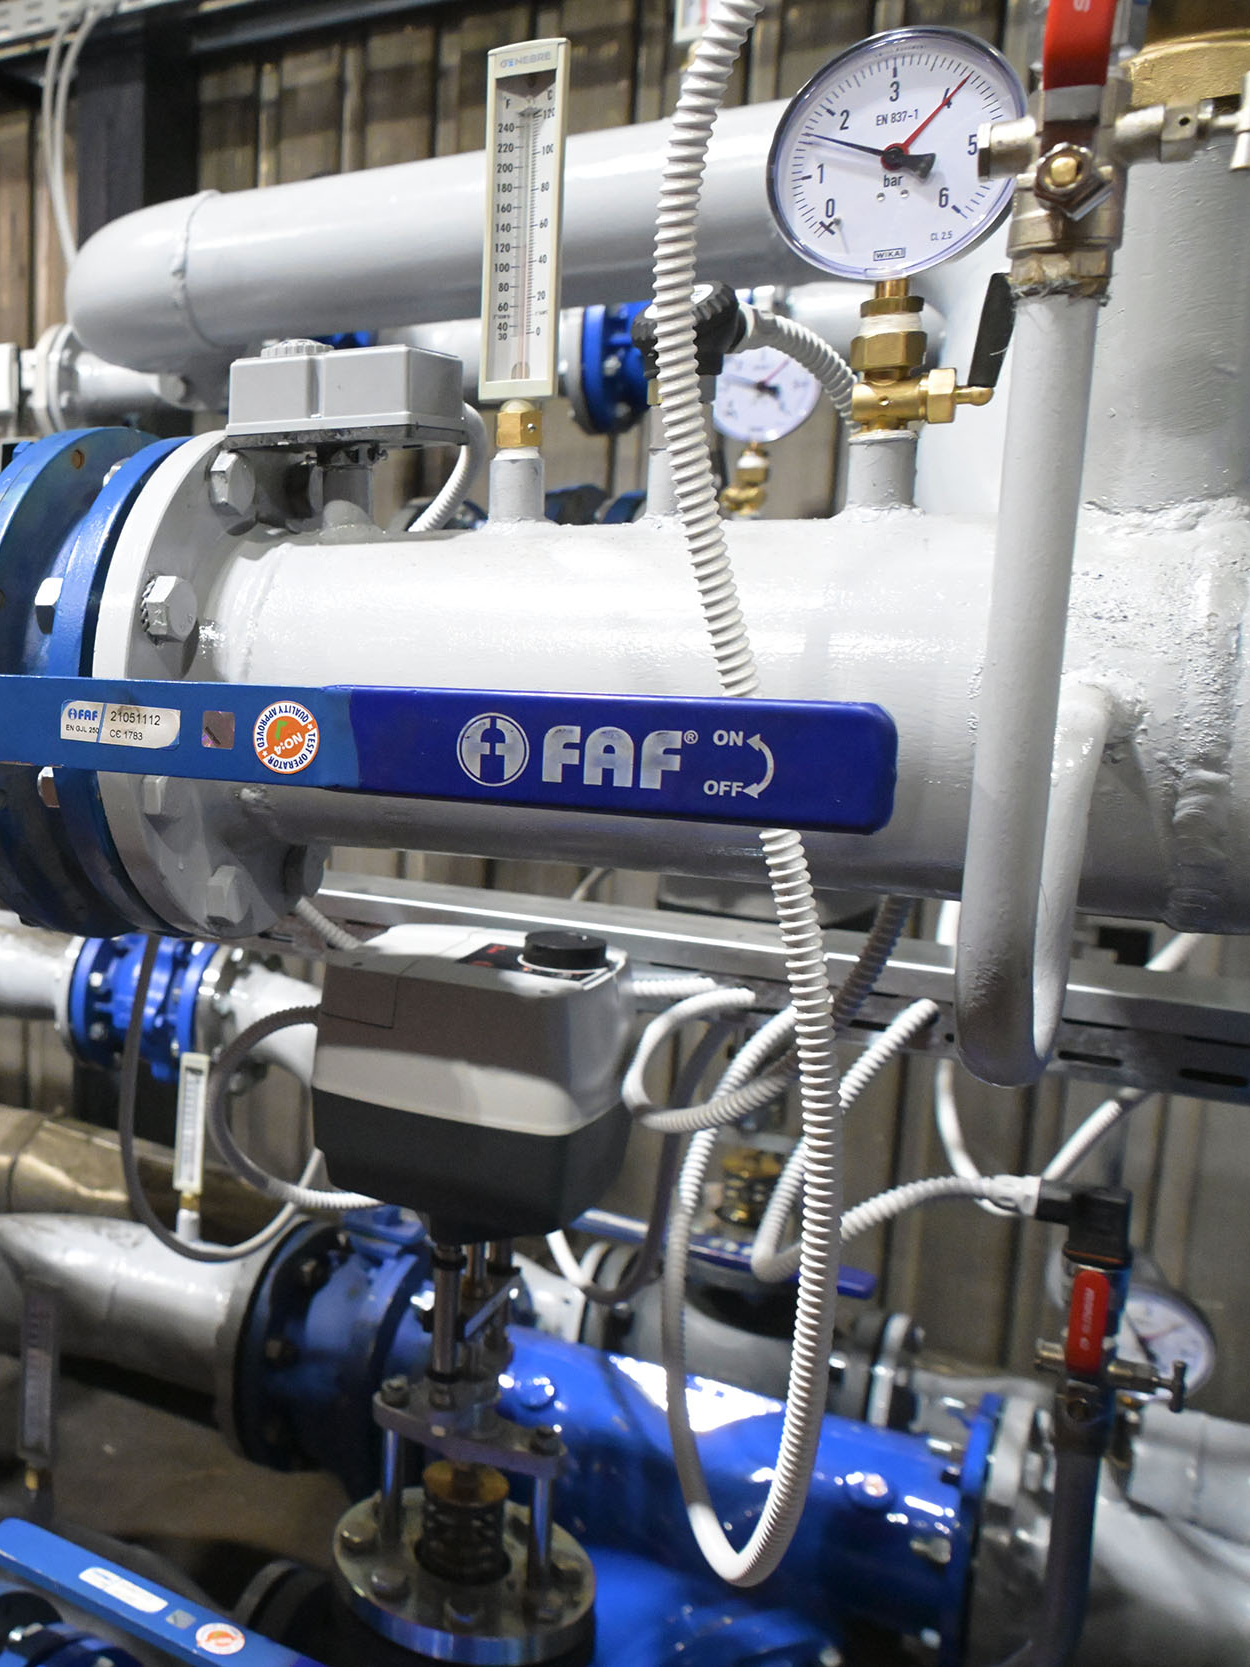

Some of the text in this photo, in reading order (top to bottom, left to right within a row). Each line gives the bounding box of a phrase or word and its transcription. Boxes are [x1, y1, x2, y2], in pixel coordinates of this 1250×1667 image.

[500, 51, 551, 68] GENEBRE
[889, 81, 900, 102] 3
[942, 87, 953, 109] 4
[840, 109, 850, 131] 2
[875, 108, 919, 126] EN 837-1
[498, 123, 515, 133] 240
[497, 143, 514, 153] 220
[968, 133, 978, 156] 5
[497, 163, 513, 173] 200
[817, 163, 824, 185] 1
[883, 174, 903, 187] bar
[496, 183, 512, 193] 180
[540, 181, 549, 192] 80
[938, 187, 949, 208] 6
[496, 203, 512, 213] 160
[825, 198, 835, 218] 0
[495, 223, 511, 233] 140
[539, 218, 549, 229] 60
[495, 243, 510, 253] 120
[538, 254, 548, 264] 40
[876, 250, 902, 259] WIKA
[494, 263, 510, 273] 100
[498, 282, 509, 292] 80
[537, 290, 546, 301] 20
[497, 302, 509, 312] 60
[497, 322, 508, 332] 40
[536, 326, 541, 336] 0
[498, 333, 507, 341] 30
[78, 709, 98, 721] FAF
[110, 710, 161, 726] 21051112
[75, 725, 87, 733] GJL
[89, 726, 99, 735] 250
[256, 704, 309, 748] QUALITY APPROVED
[124, 730, 143, 741] 1783
[712, 729, 744, 747] ON
[273, 732, 303, 755] NO:4
[267, 732, 315, 770] TEST OPERATOR
[703, 779, 744, 797] OFF
